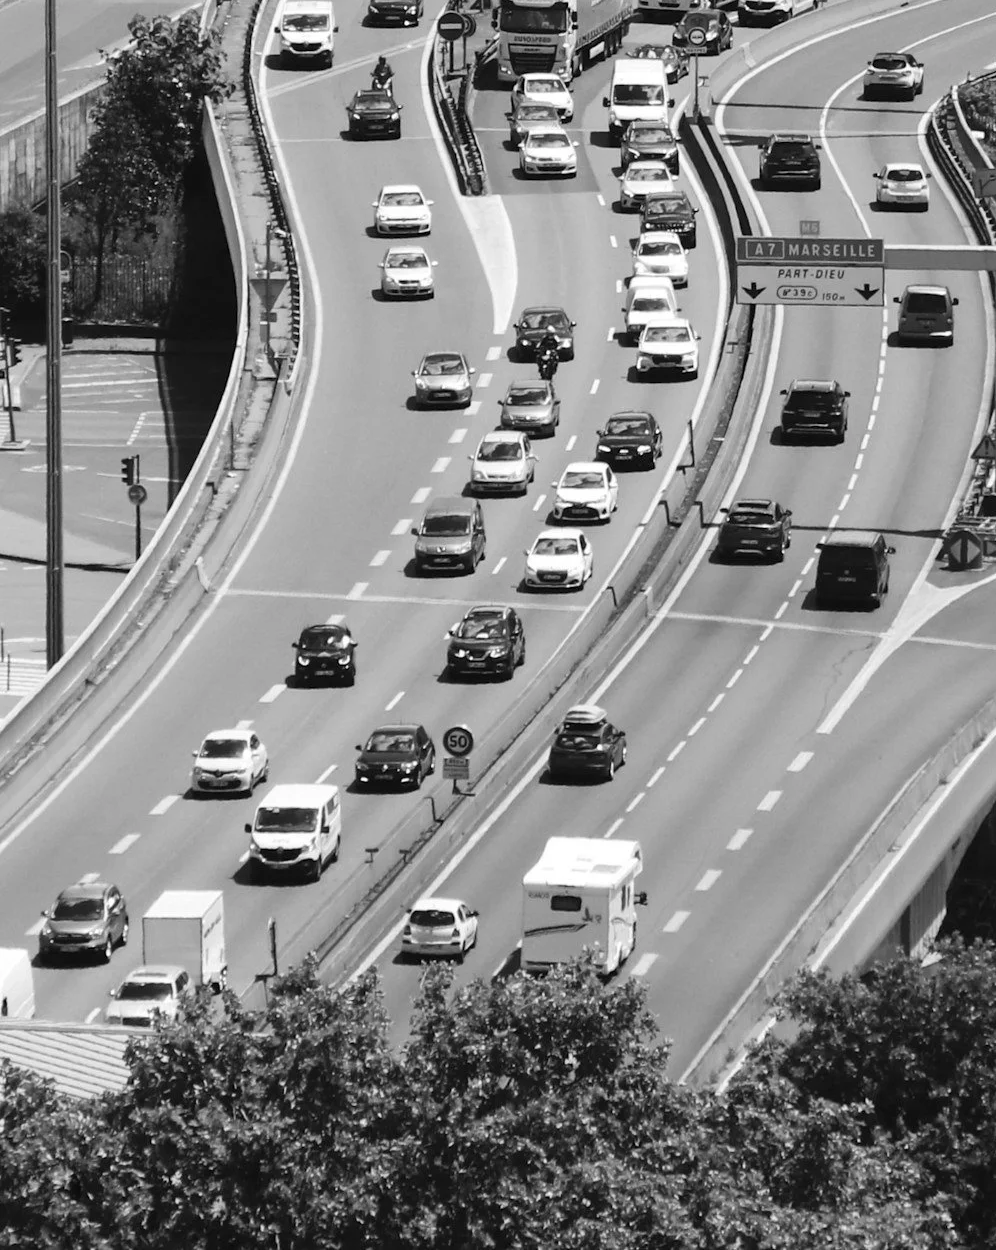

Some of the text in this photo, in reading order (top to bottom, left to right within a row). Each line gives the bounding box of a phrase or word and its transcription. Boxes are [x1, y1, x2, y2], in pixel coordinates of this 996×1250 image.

[788, 243, 876, 258] MARSEILLE
[777, 269, 845, 280] PART-DIEU
[449, 735, 468, 748] 50
